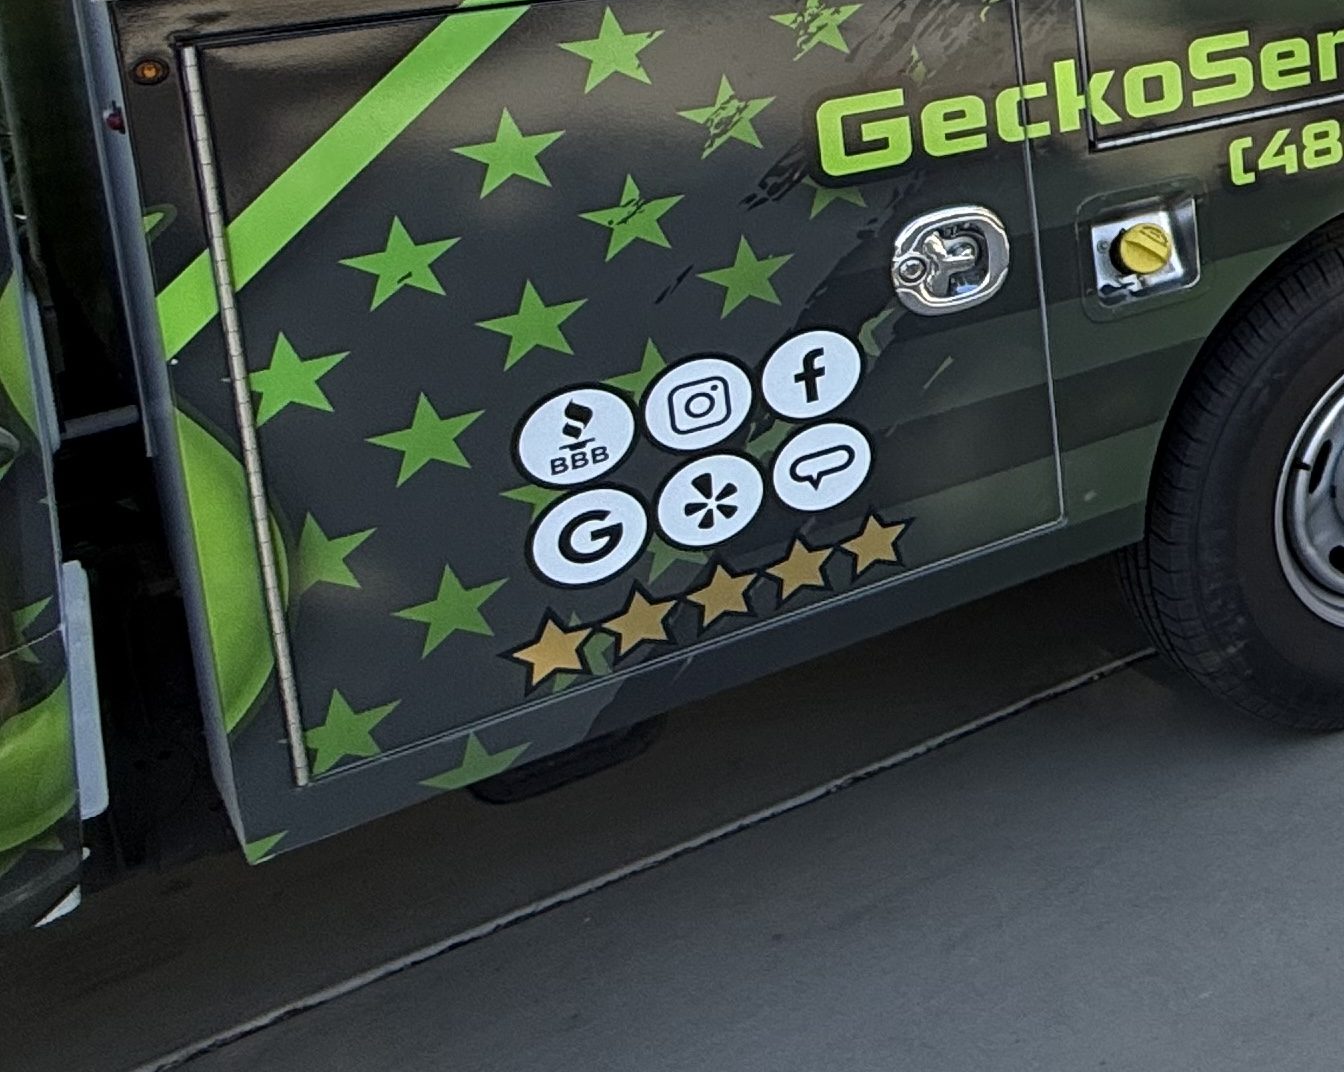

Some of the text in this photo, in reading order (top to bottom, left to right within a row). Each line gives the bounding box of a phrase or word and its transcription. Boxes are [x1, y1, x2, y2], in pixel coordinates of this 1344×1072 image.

[794, 347, 826, 403] f
[550, 446, 610, 476] BBB
[558, 509, 624, 564] G
